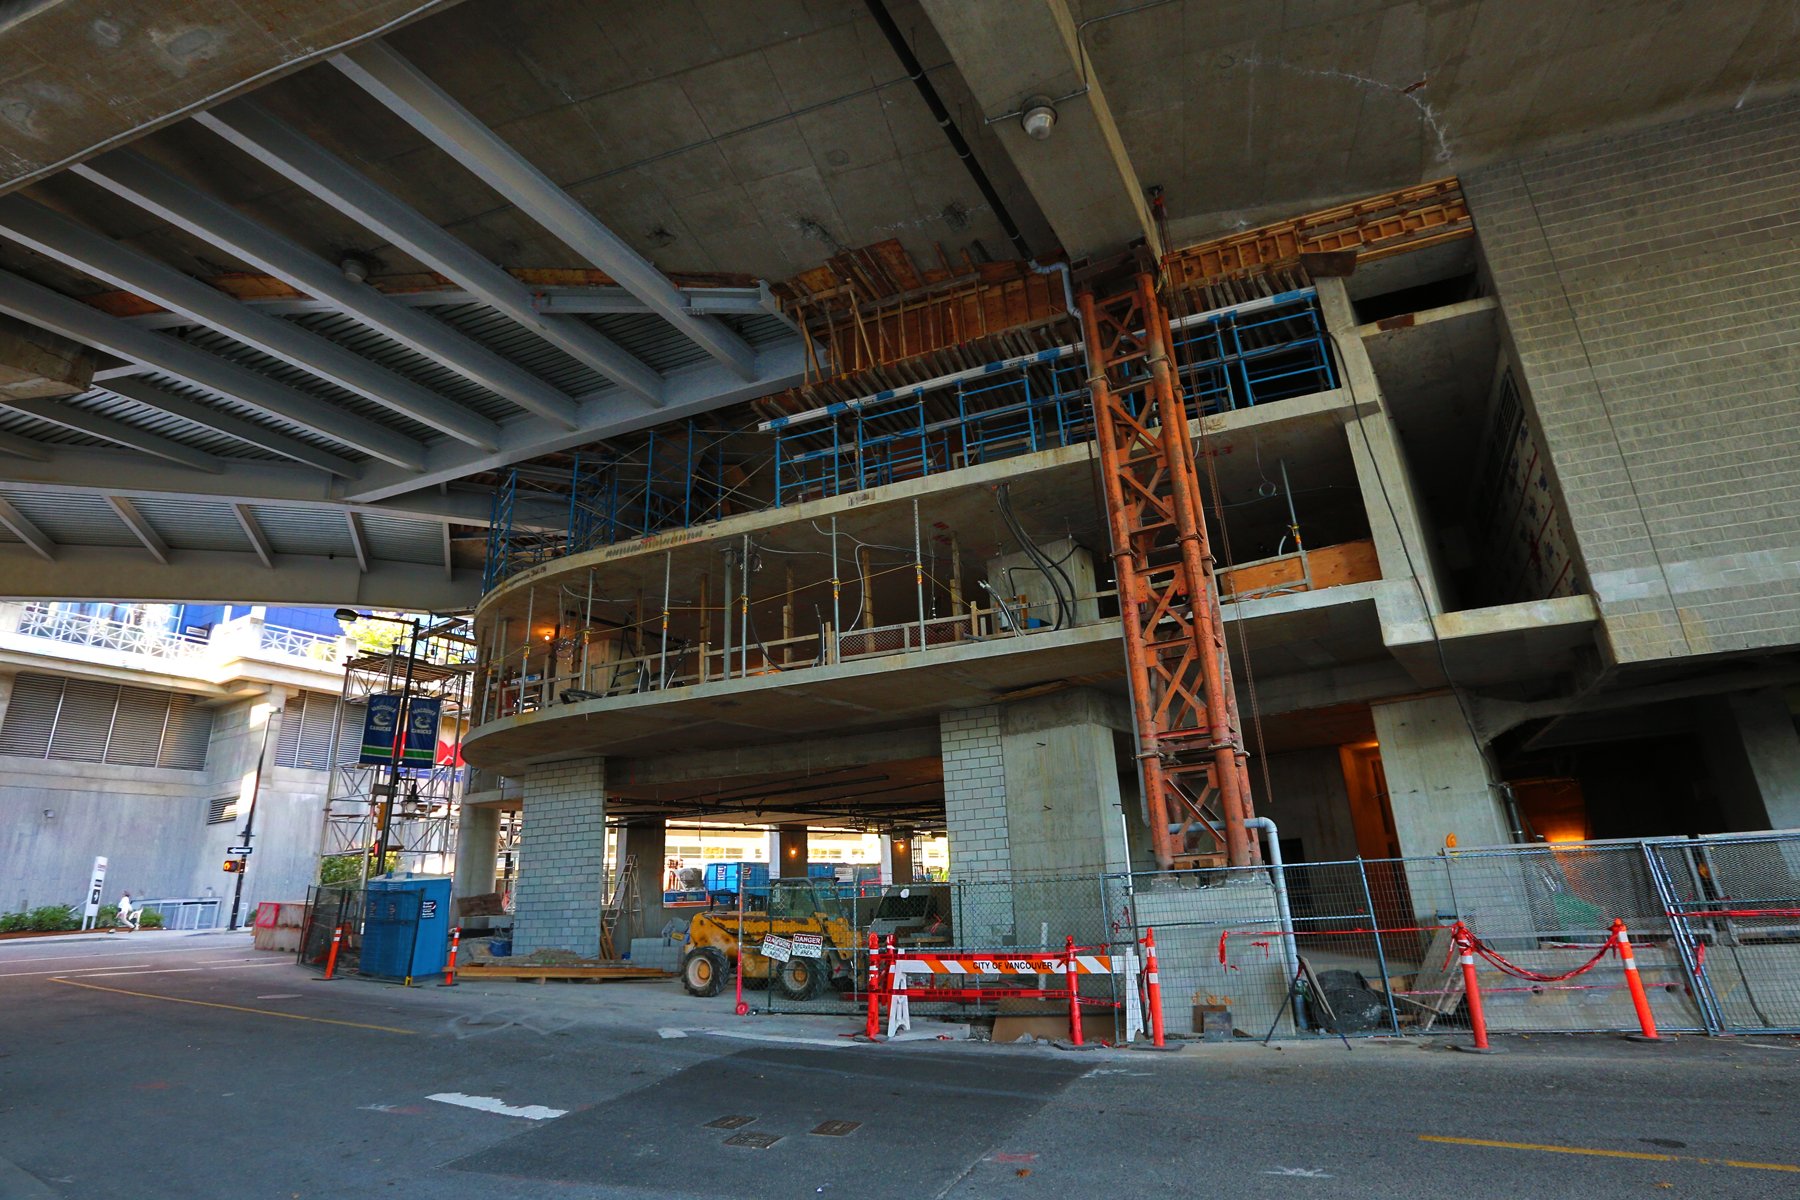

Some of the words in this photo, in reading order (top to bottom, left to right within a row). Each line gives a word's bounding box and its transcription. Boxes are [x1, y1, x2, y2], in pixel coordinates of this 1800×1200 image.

[795, 936, 821, 944] DANGER
[973, 961, 990, 970] CITY
[992, 961, 1002, 970] OF
[1004, 961, 1053, 970] VANCOUVER
